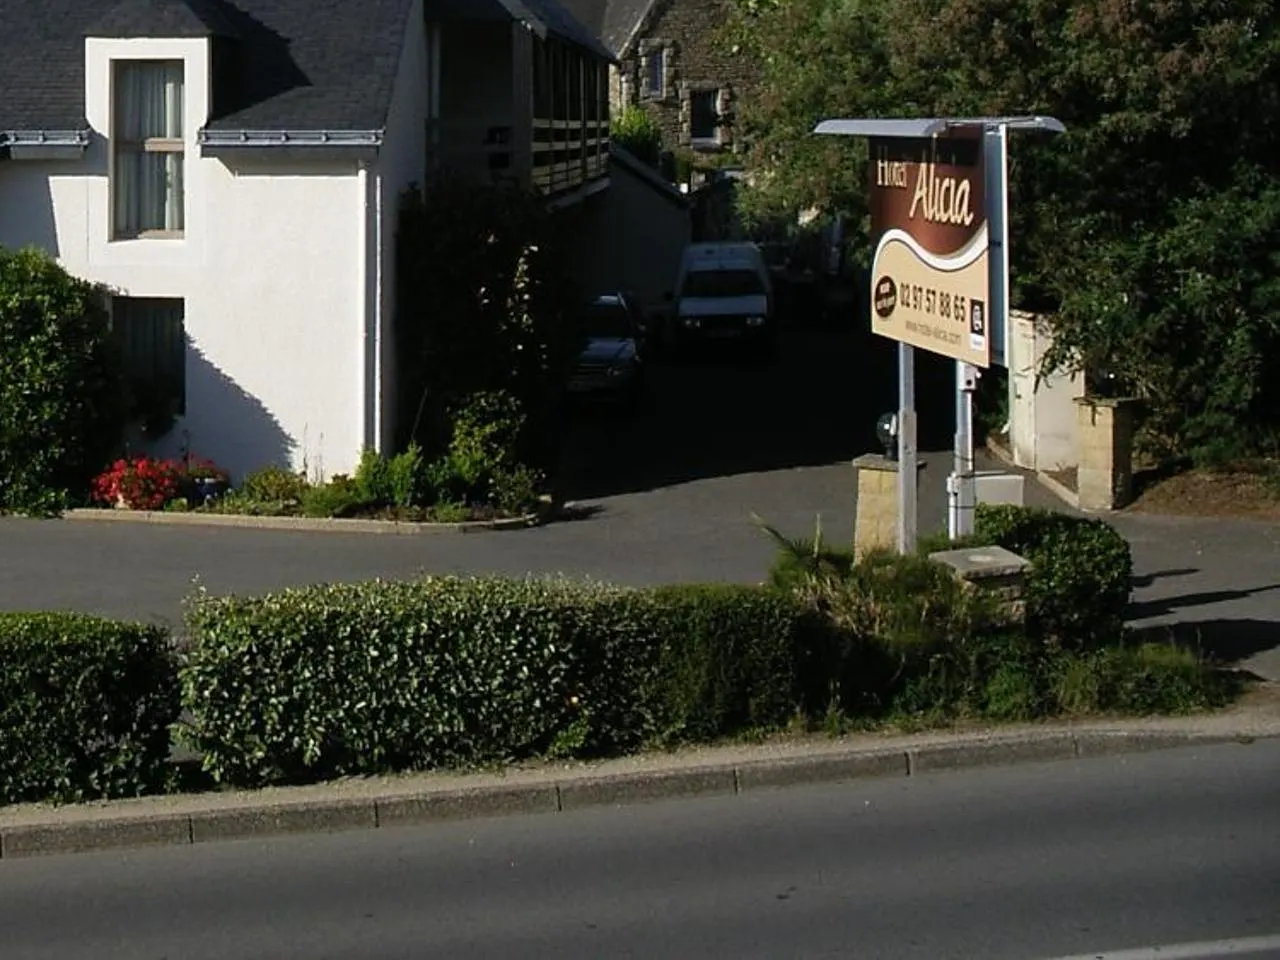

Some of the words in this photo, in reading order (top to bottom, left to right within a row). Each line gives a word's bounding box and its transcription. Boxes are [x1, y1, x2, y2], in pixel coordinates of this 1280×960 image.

[909, 134, 974, 226] Alicia
[900, 282, 910, 309] 02
[925, 288, 936, 314] 57
